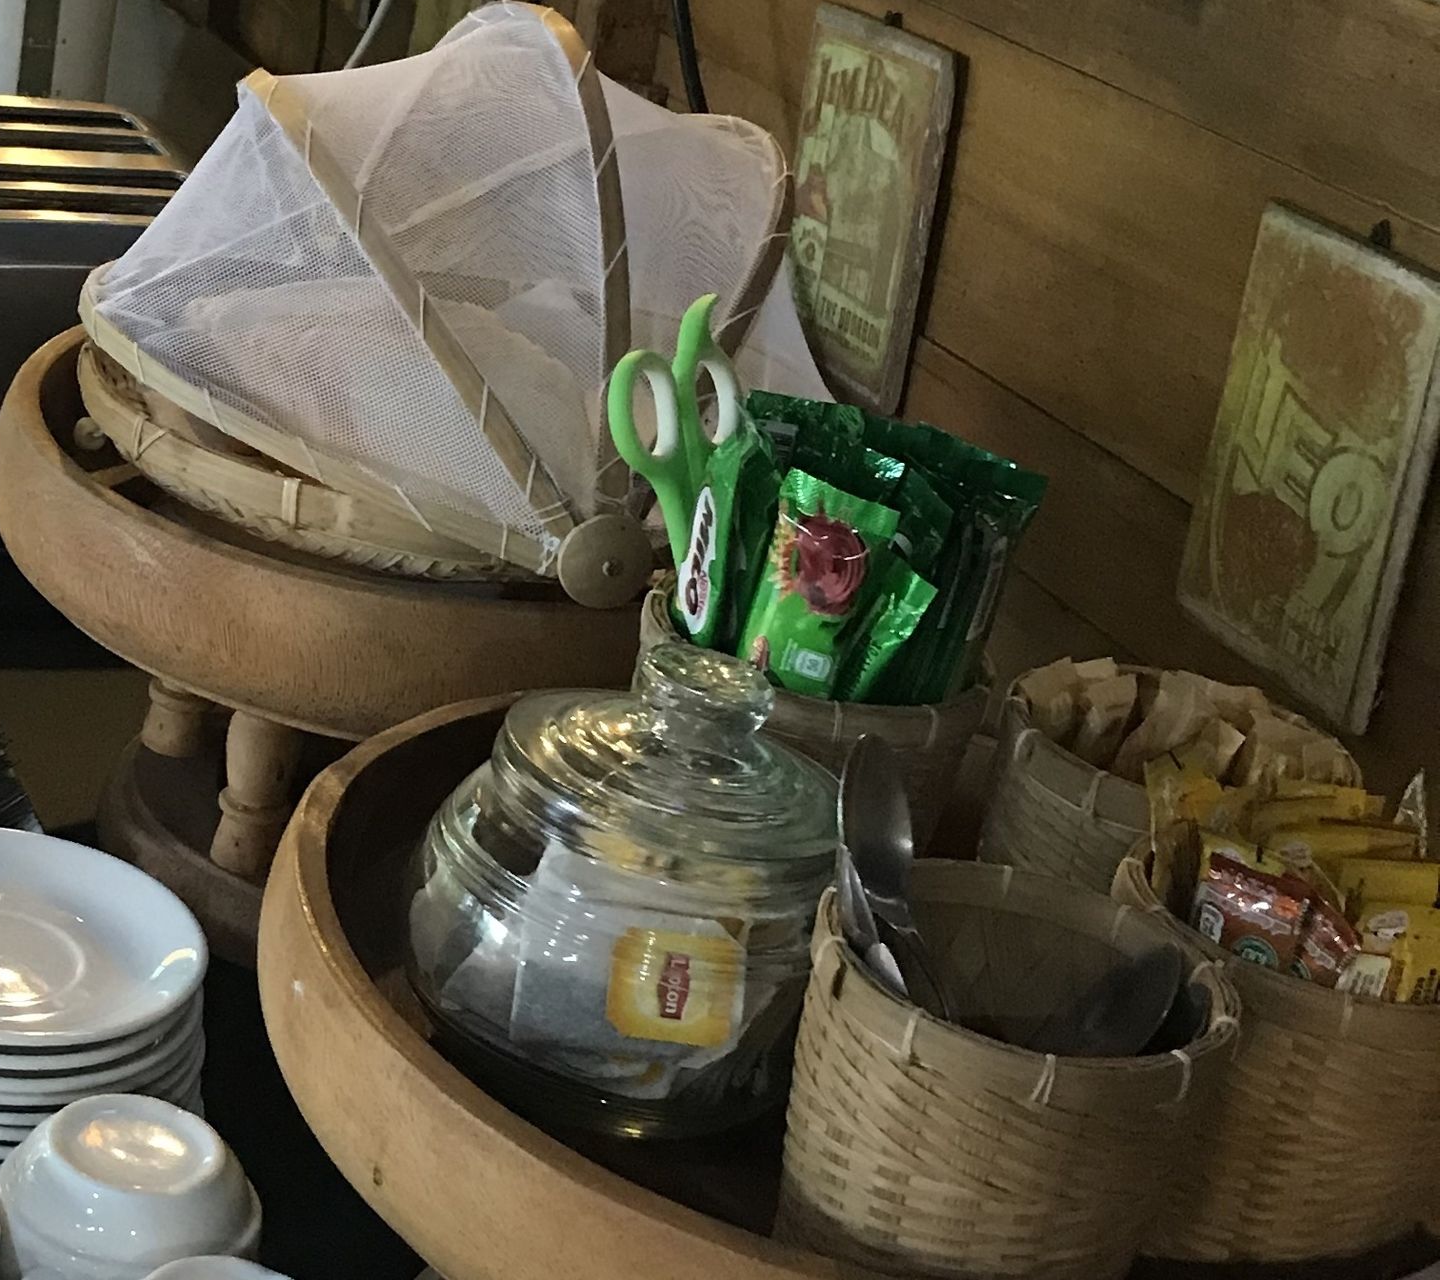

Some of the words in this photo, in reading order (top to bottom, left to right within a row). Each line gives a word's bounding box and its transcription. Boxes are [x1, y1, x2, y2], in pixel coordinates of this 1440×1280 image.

[802, 57, 861, 133] JIM
[685, 494, 714, 616] MILO
[664, 956, 688, 1014] Lpton
